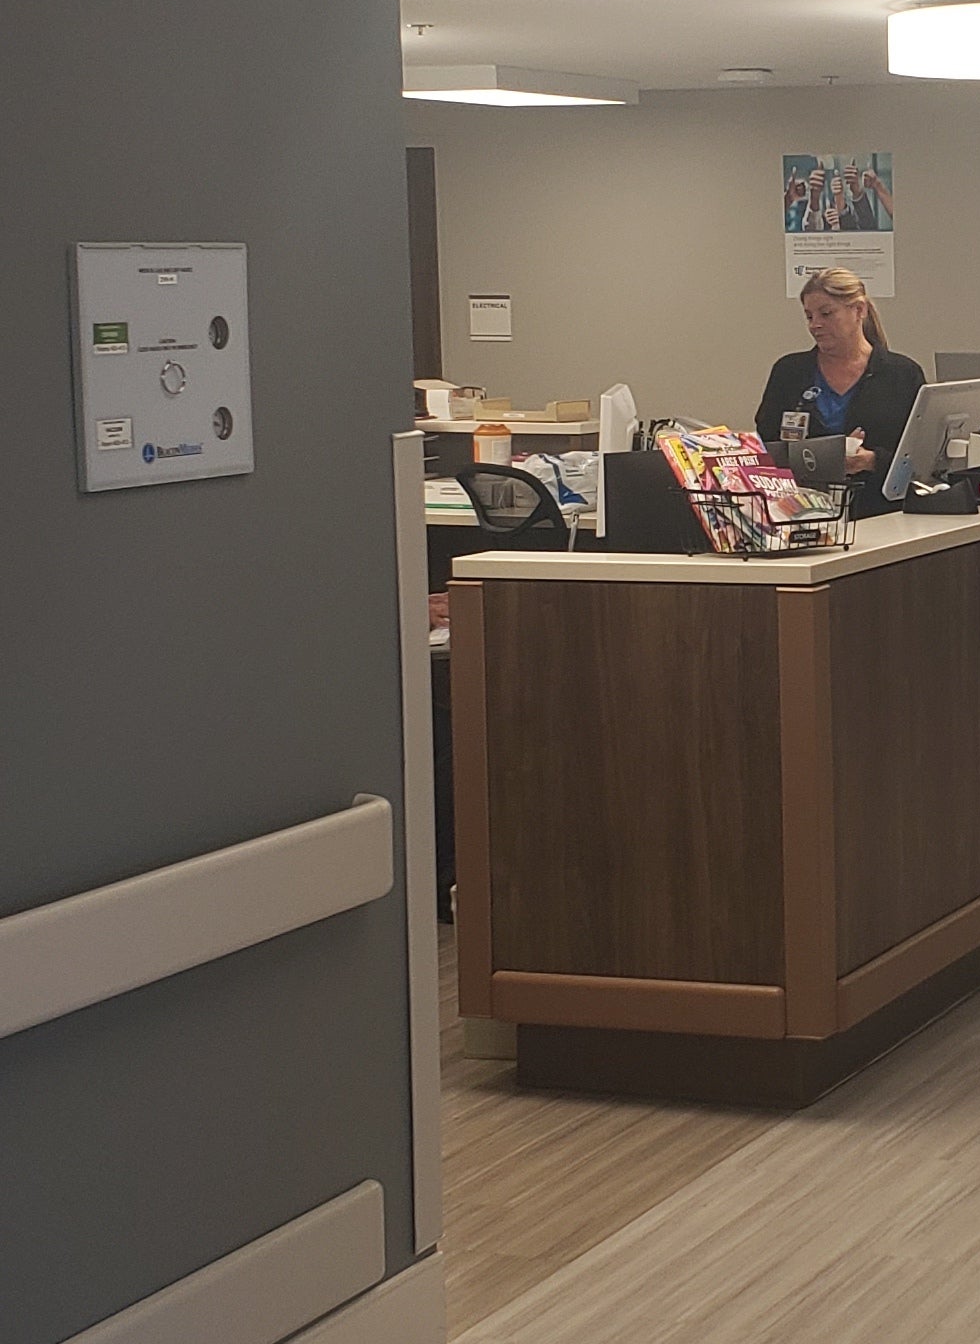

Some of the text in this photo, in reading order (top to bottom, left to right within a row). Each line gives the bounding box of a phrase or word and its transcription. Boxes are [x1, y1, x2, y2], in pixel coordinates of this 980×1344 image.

[716, 455, 760, 467] LARGE PRINT
[748, 474, 798, 492] SUDOKU
